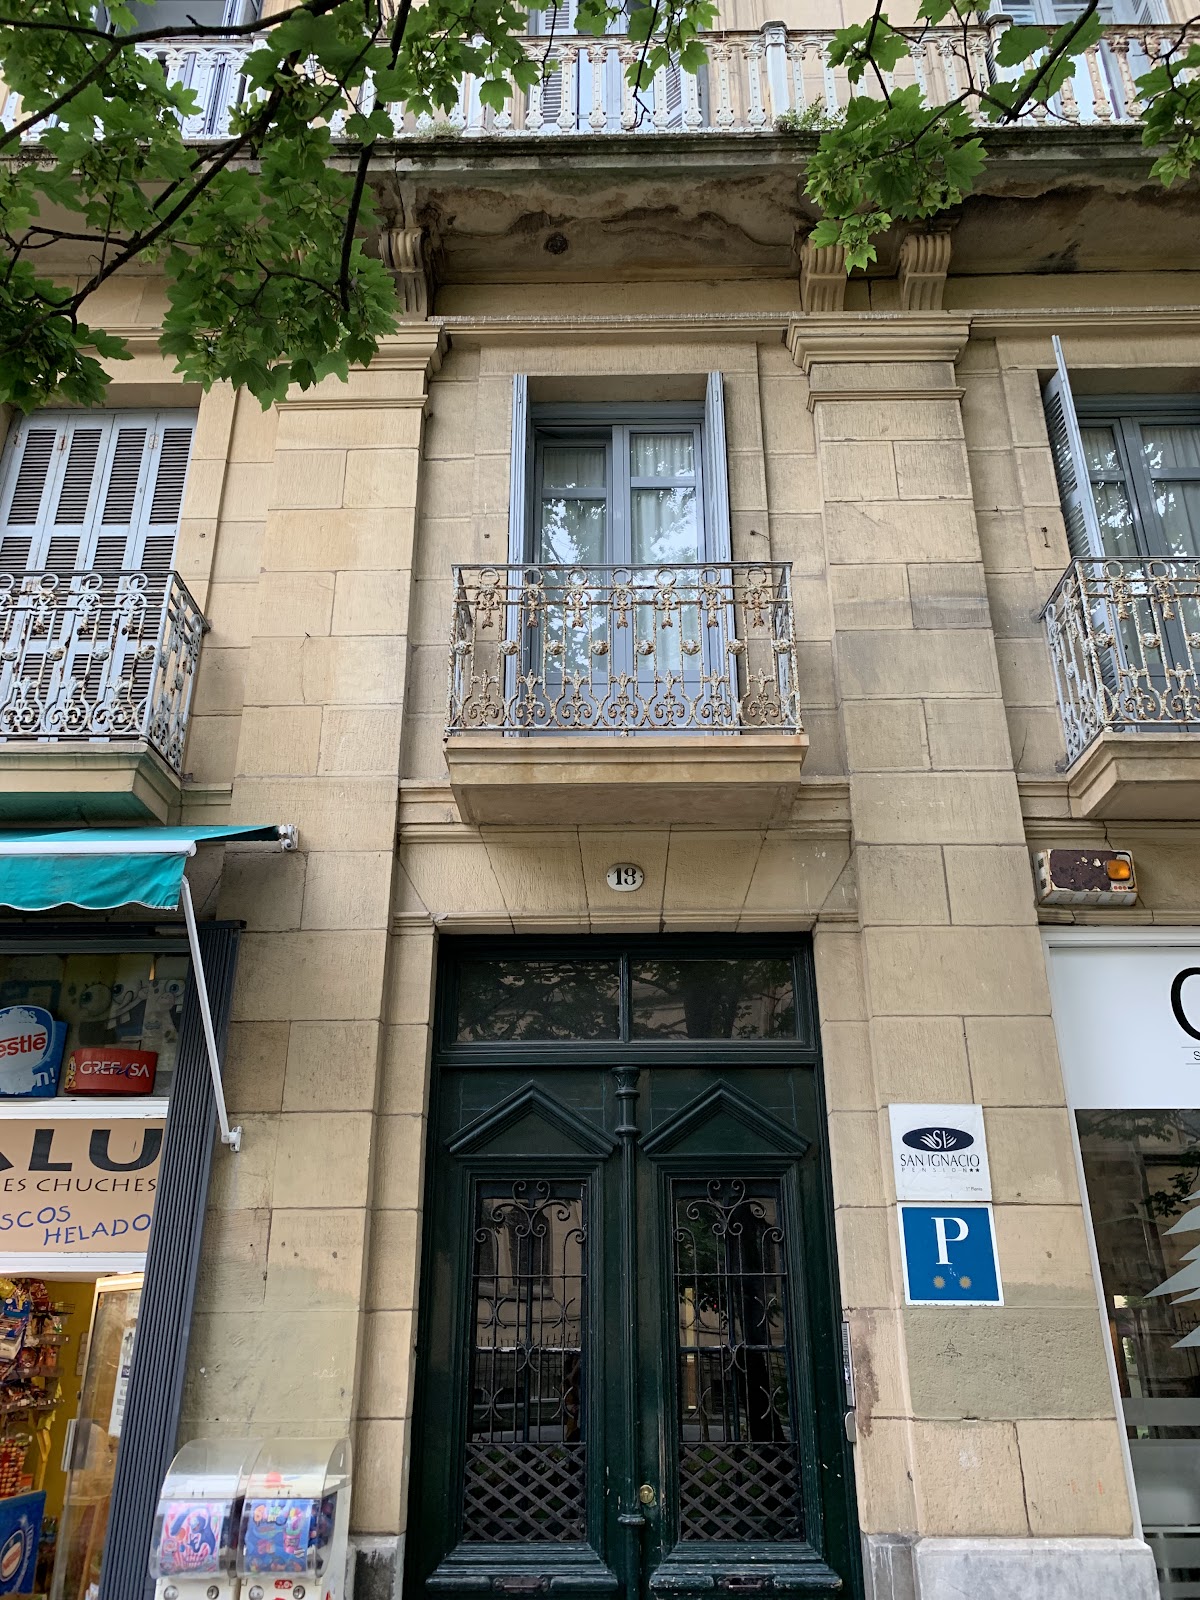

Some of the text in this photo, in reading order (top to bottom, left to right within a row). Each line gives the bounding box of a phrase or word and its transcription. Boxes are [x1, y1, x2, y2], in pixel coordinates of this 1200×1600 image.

[612, 867, 637, 886] 18
[900, 1153, 980, 1168] SAN IGNACIO
[36, 1177, 157, 1193] CHUCHES
[930, 1217, 969, 1265] P
